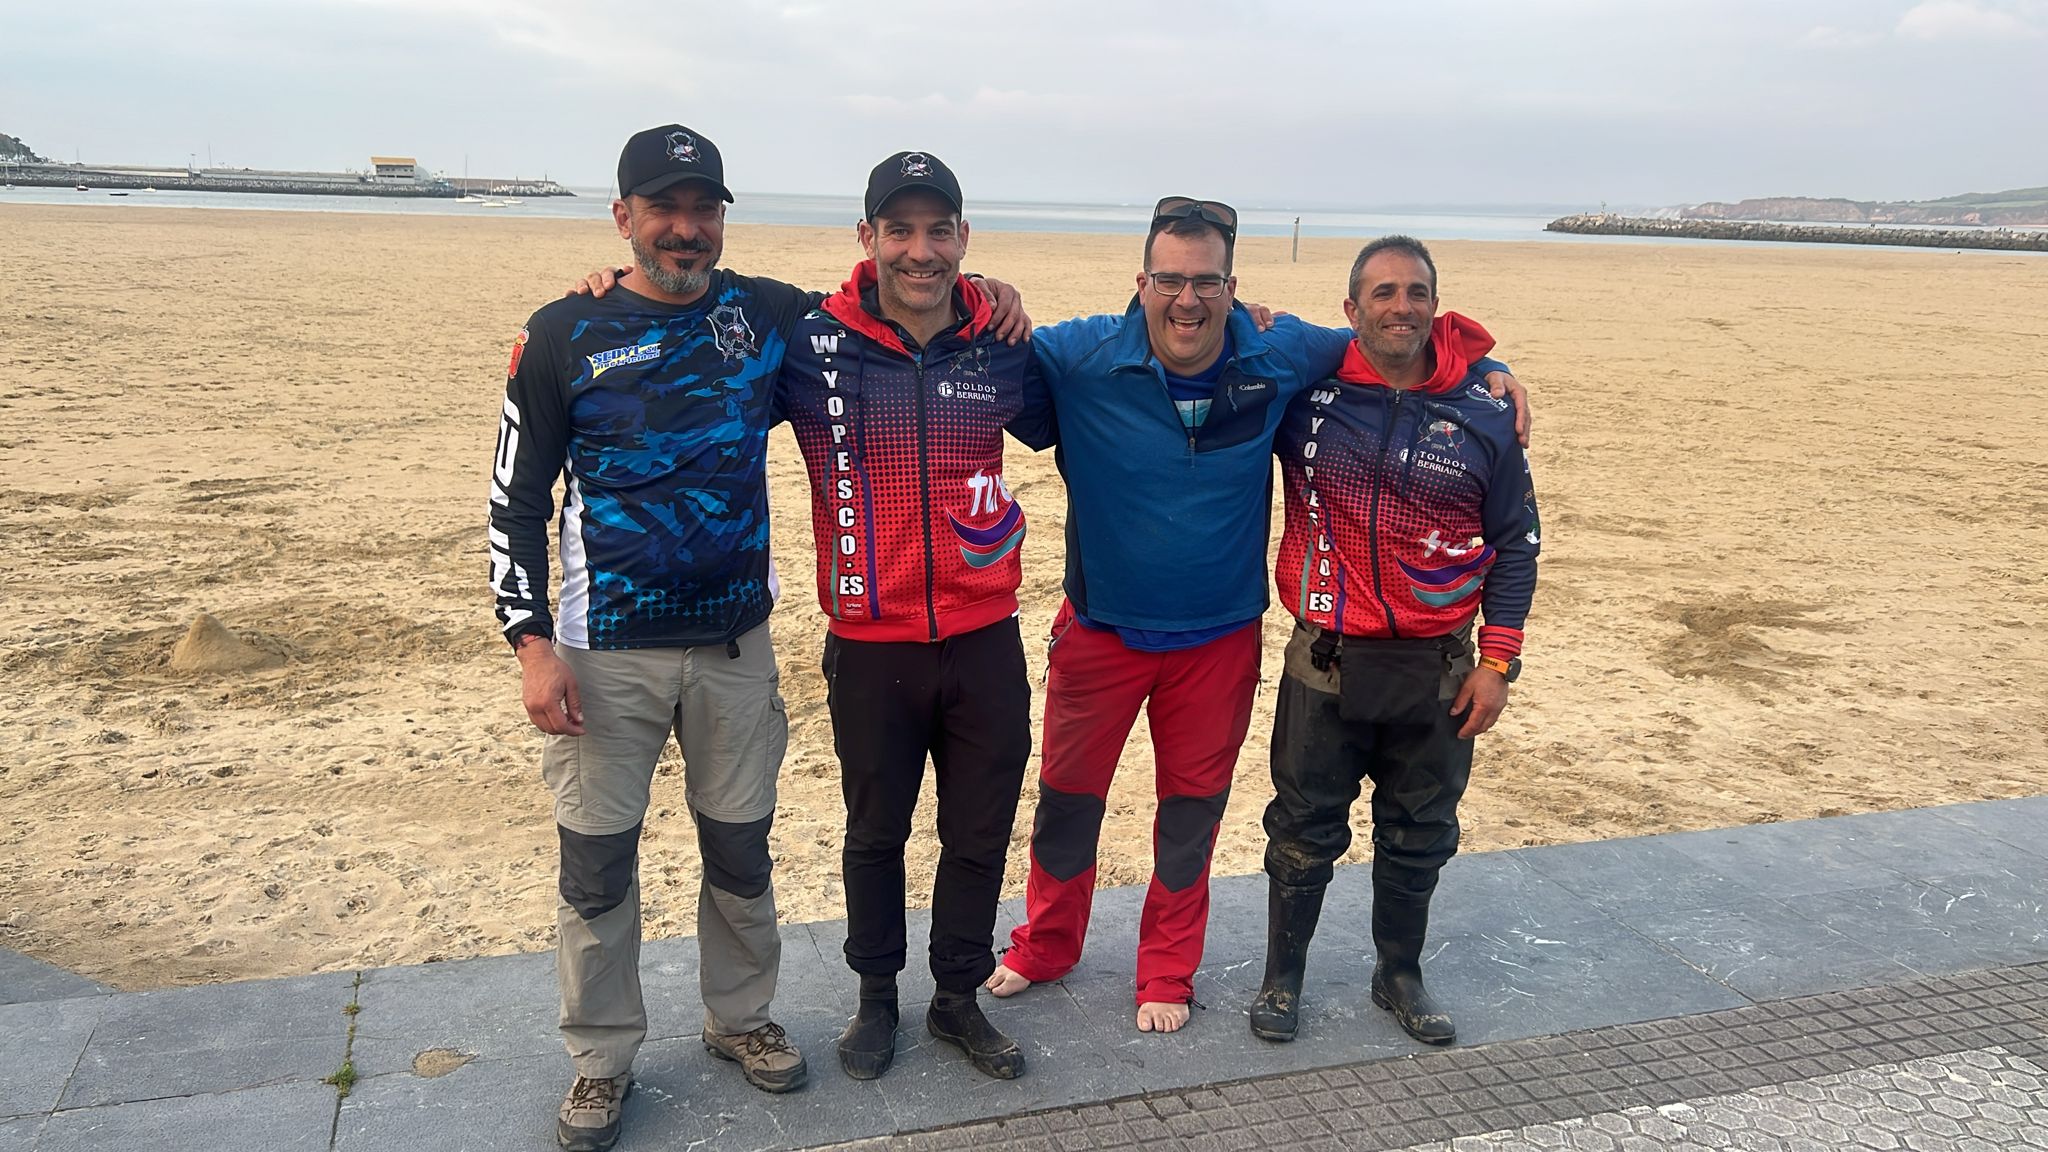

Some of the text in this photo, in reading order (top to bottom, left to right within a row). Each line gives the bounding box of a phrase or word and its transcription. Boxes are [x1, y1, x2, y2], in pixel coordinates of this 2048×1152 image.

[955, 382, 997, 394] TOLDOS
[956, 391, 996, 403] BERRIAINZ
[1420, 451, 1467, 470] TOLDOS
[1417, 459, 1463, 478] BERRIAINZ
